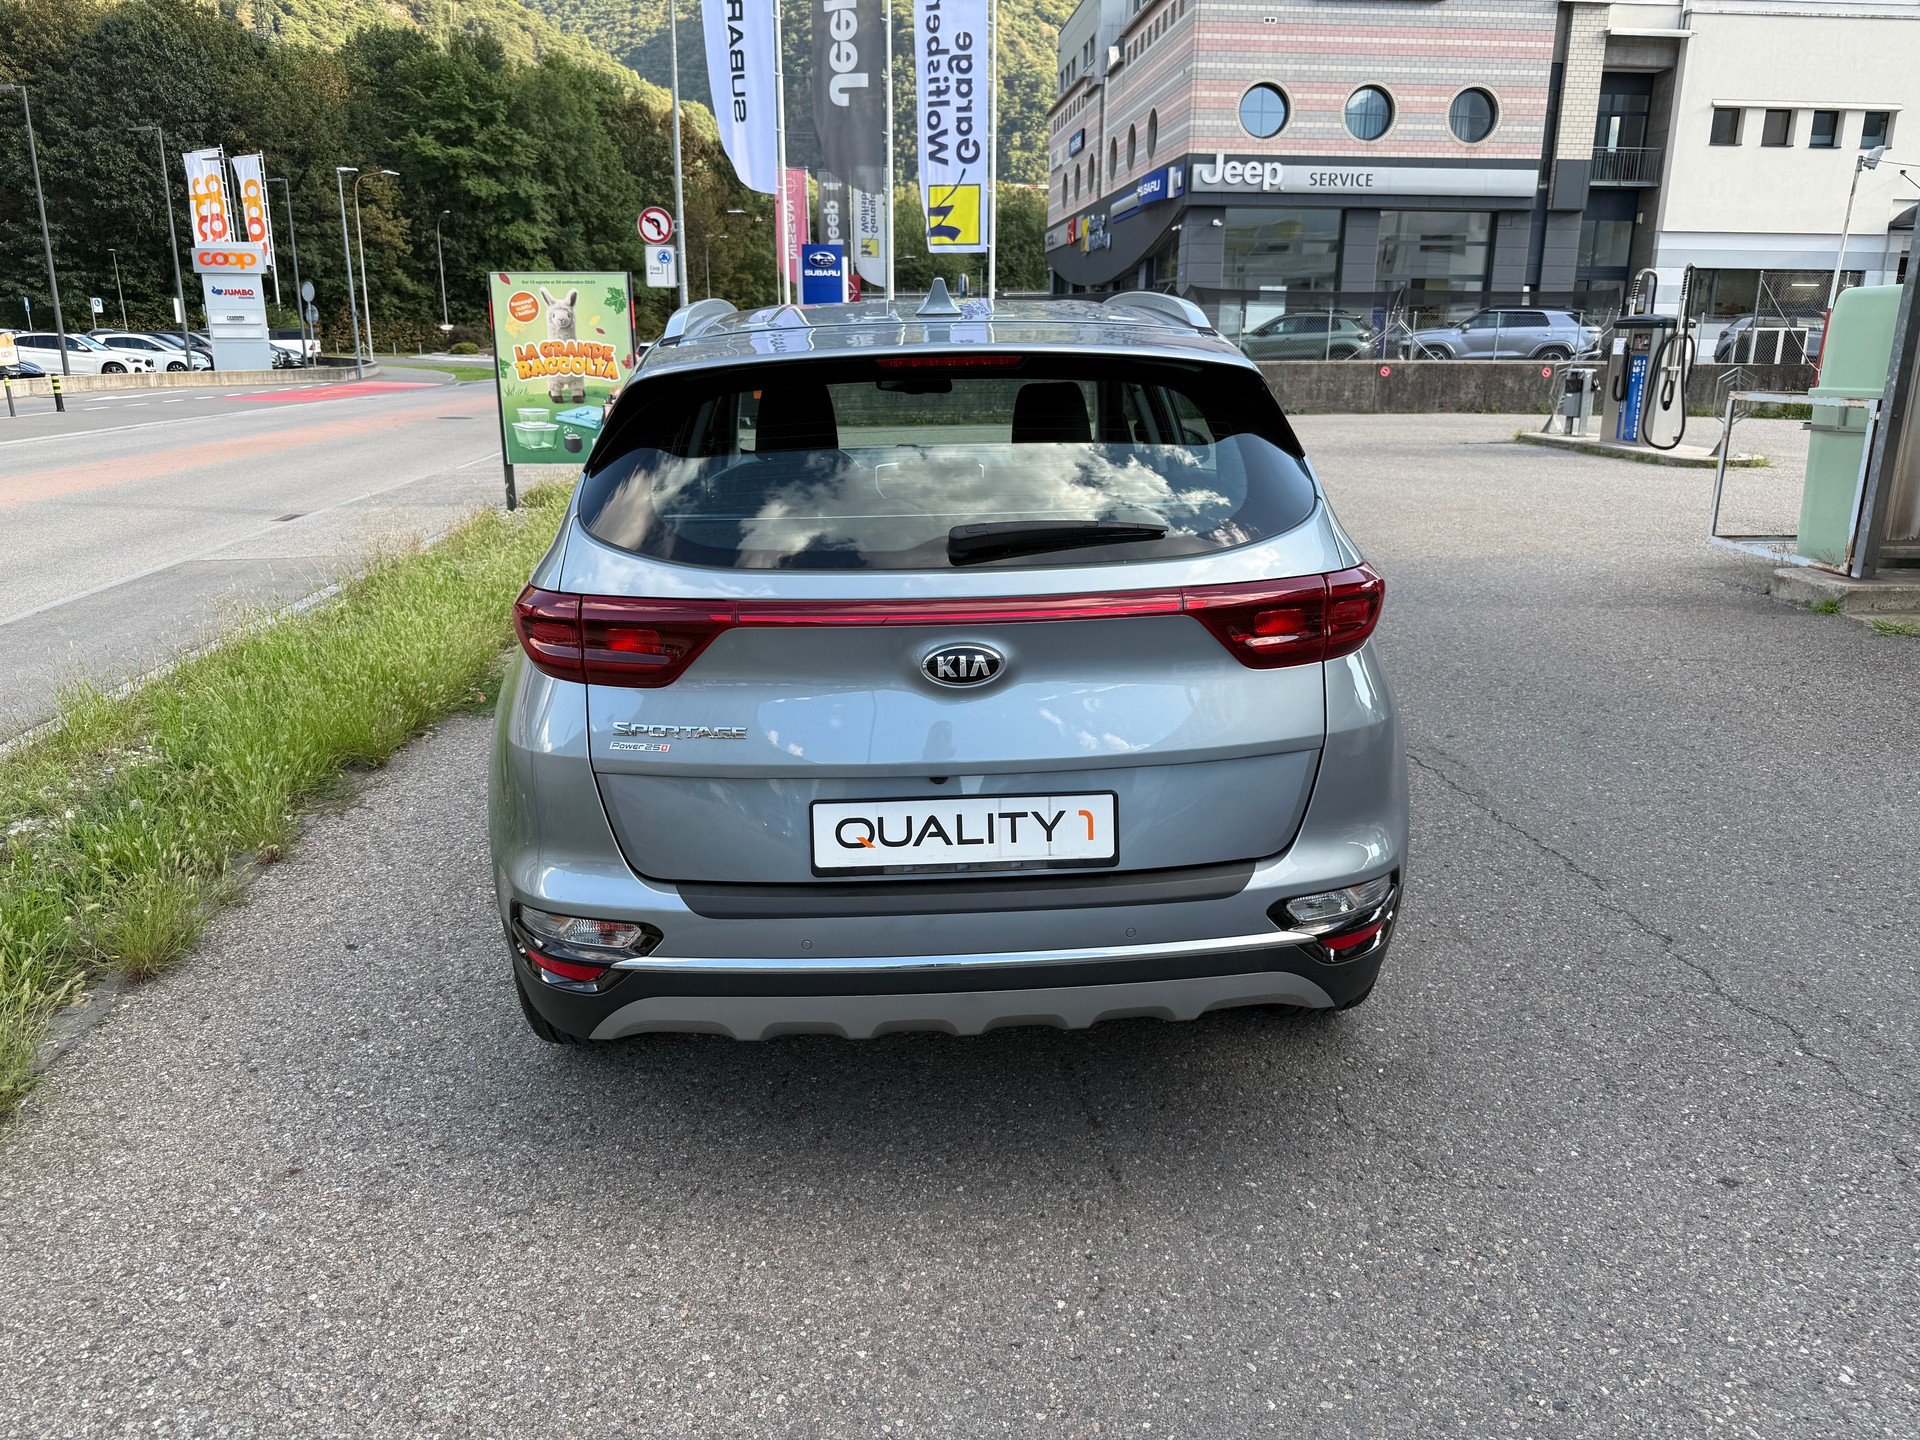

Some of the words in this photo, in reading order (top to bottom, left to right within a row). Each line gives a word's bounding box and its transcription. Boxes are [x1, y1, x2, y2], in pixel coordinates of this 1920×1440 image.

[1201, 153, 1285, 191] Jeep
[1309, 172, 1374, 188] SERVICE
[198, 251, 257, 271] coop
[804, 269, 841, 277] SUBARU
[223, 288, 254, 296] JUMBO
[514, 343, 539, 361] LA
[539, 340, 615, 362] GRANDE
[515, 357, 620, 380] RACCOLTA
[936, 654, 990, 678] KIA
[612, 721, 748, 740] SPORTAGE
[611, 742, 662, 752] Power25
[835, 810, 1067, 849] QUALITY
[1078, 809, 1095, 841] 1
